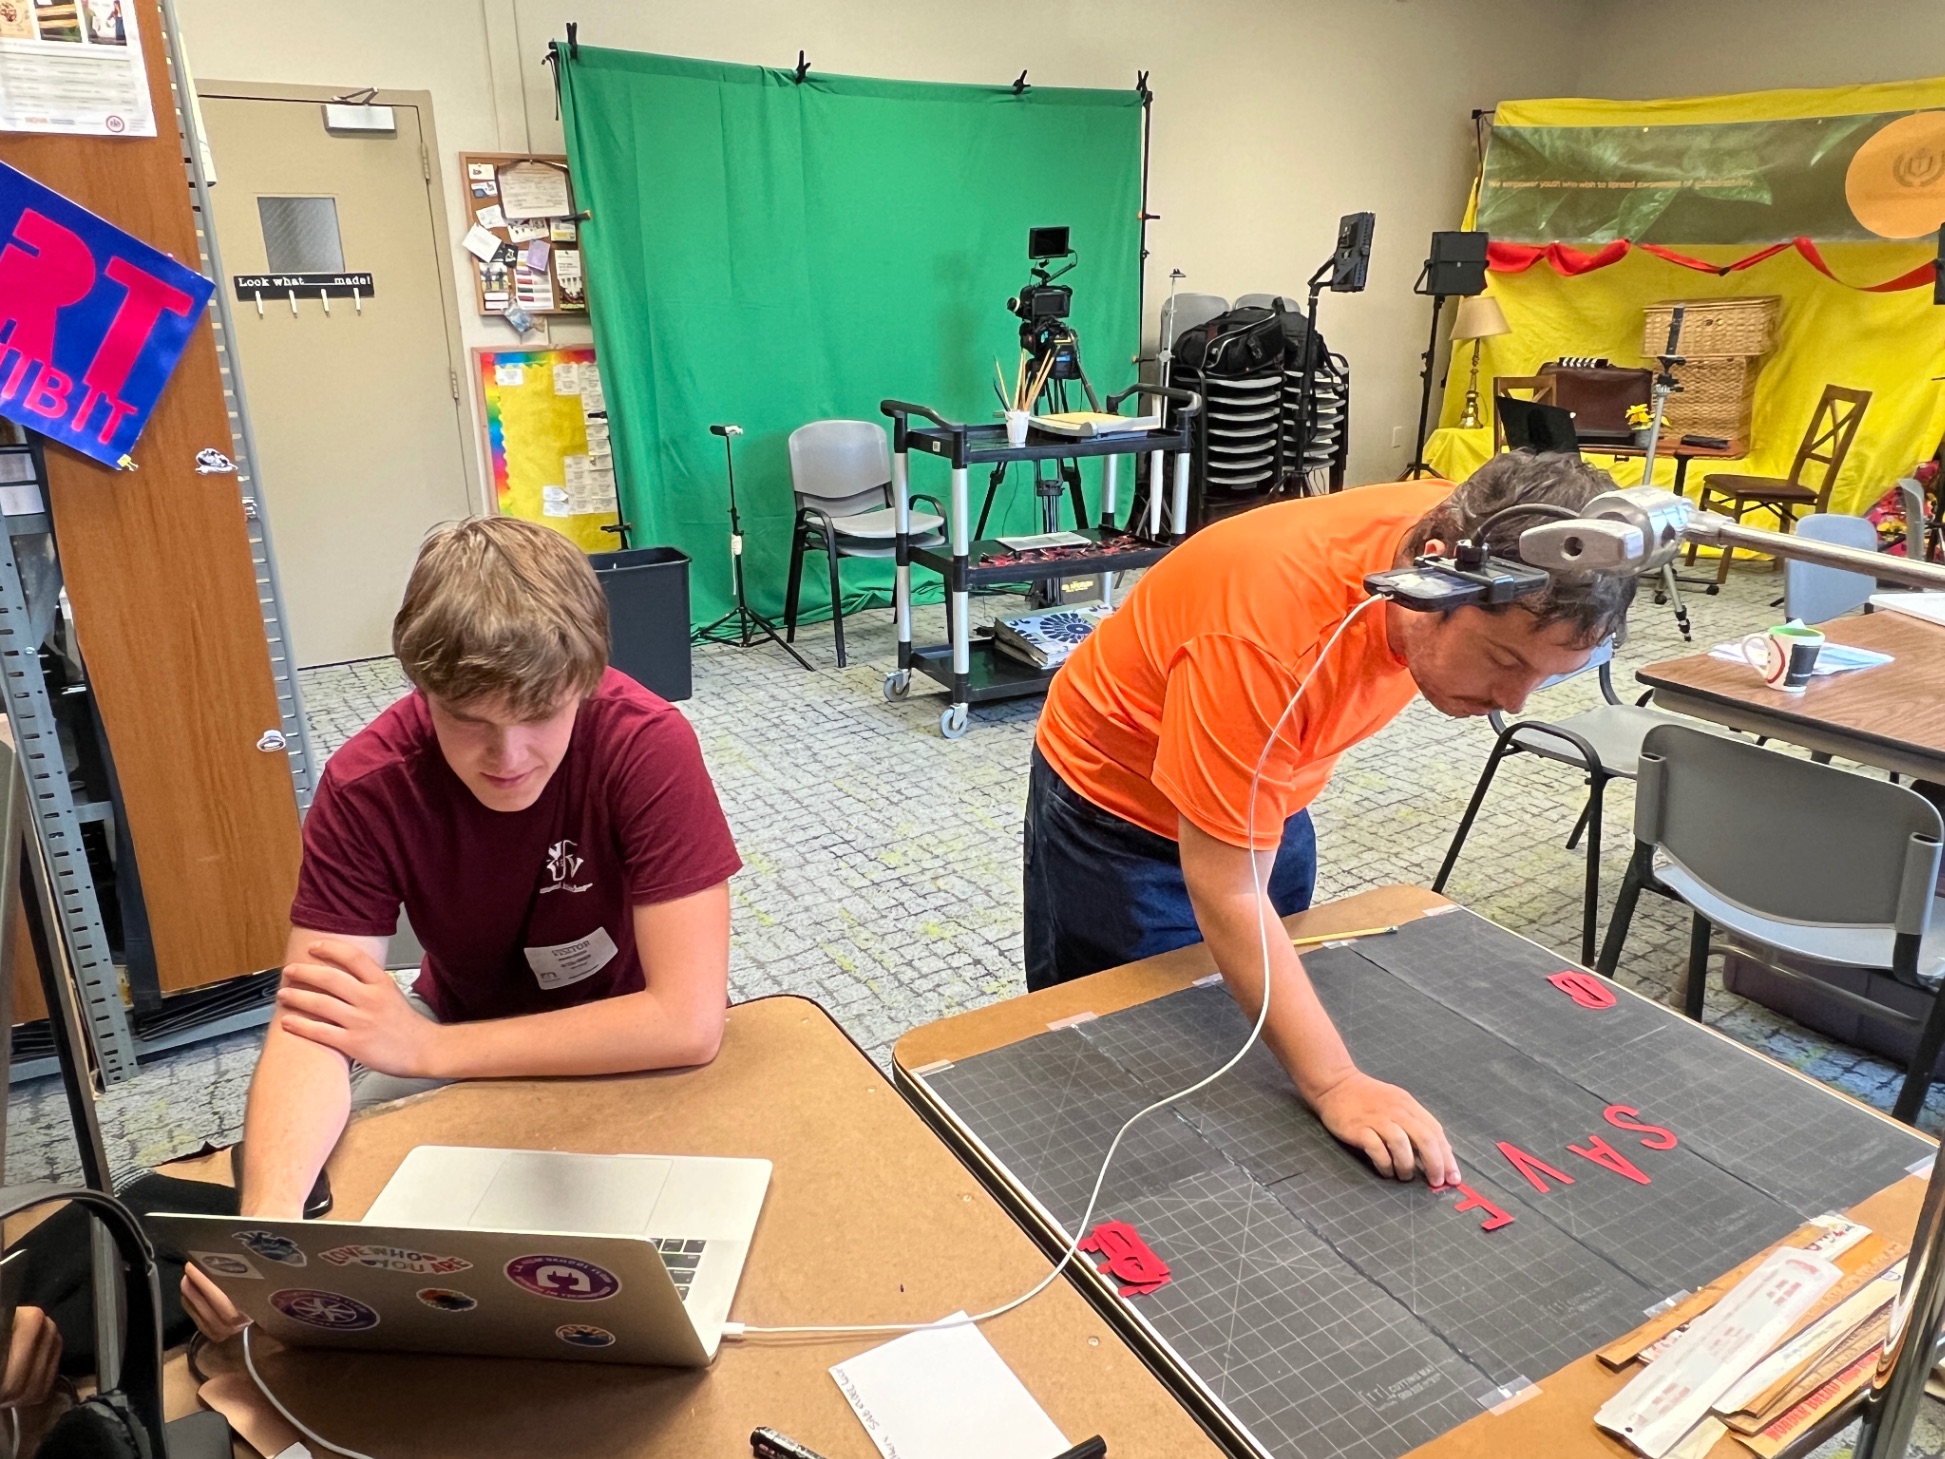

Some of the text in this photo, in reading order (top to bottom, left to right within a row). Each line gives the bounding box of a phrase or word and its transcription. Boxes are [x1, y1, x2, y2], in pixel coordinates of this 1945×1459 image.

[1597, 181, 1607, 189] to
[238, 277, 271, 287] Look
[272, 276, 305, 286] what
[0, 342, 138, 445] IBIT
[1428, 1103, 1679, 1231] SAVE
[321, 1244, 423, 1266] LOVE WHO
[375, 1256, 469, 1274] YOU ARE
